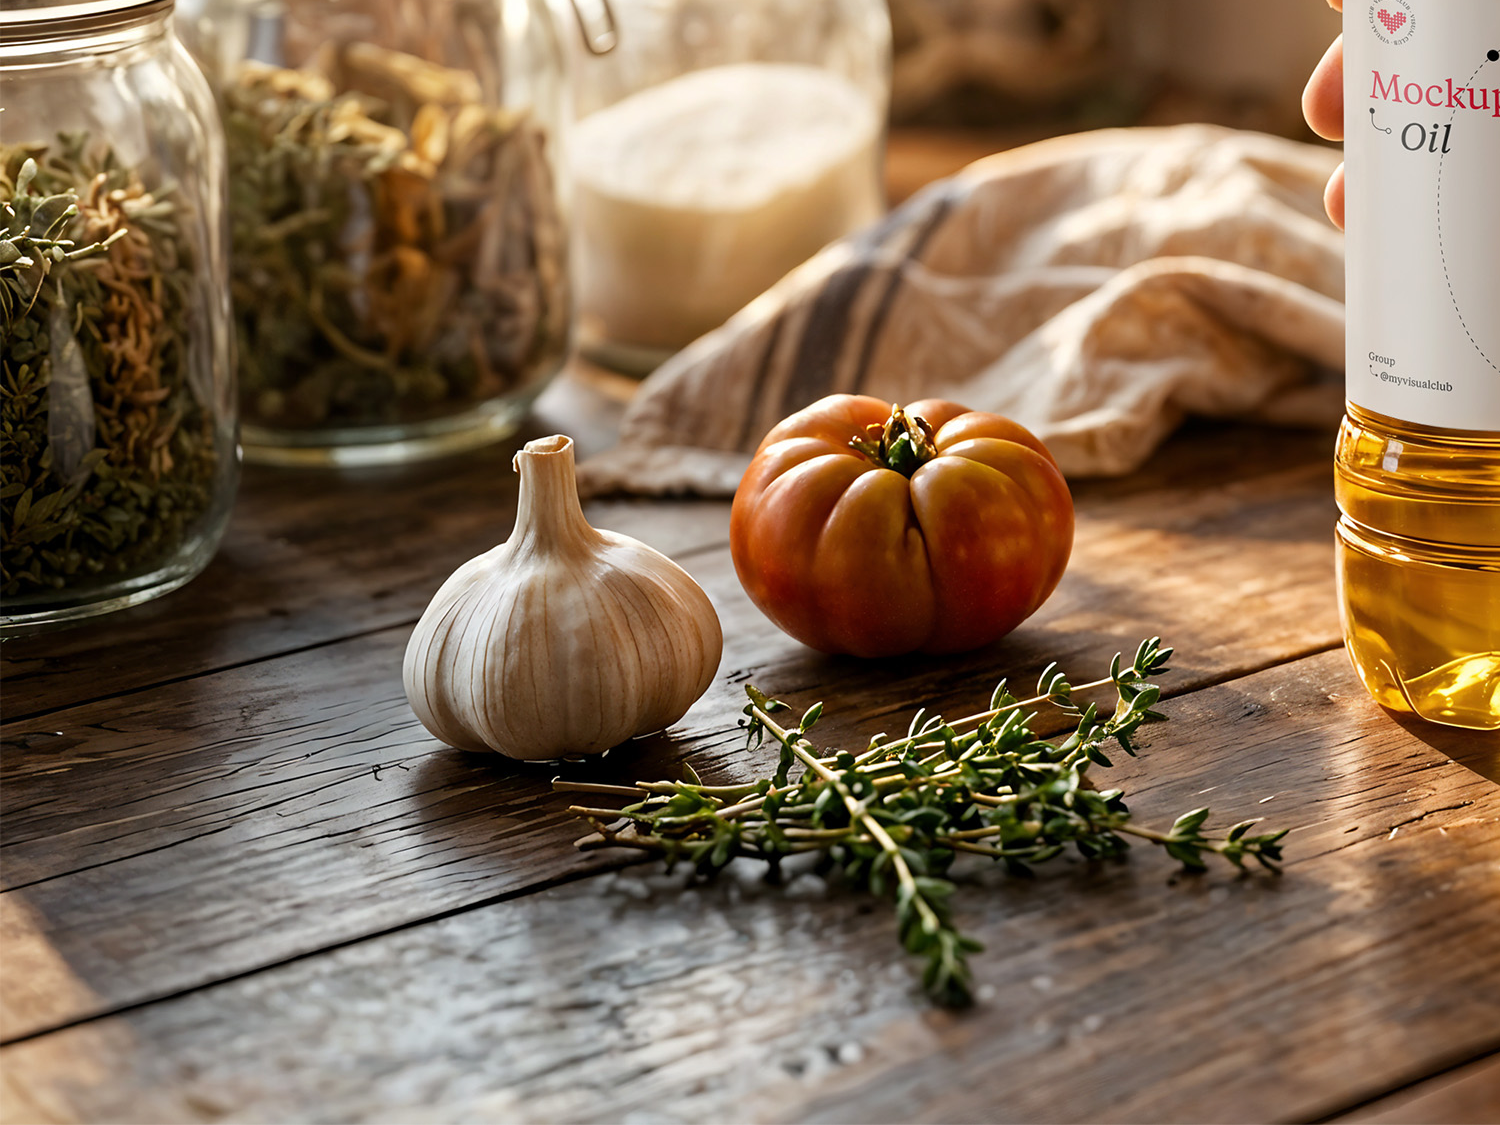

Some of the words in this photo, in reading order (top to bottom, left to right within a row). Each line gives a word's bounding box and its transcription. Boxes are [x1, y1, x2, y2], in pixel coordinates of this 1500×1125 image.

[1400, 122, 1453, 154] Oil
[1368, 351, 1396, 367] Group
[1379, 371, 1453, 392] @myvisualclub
